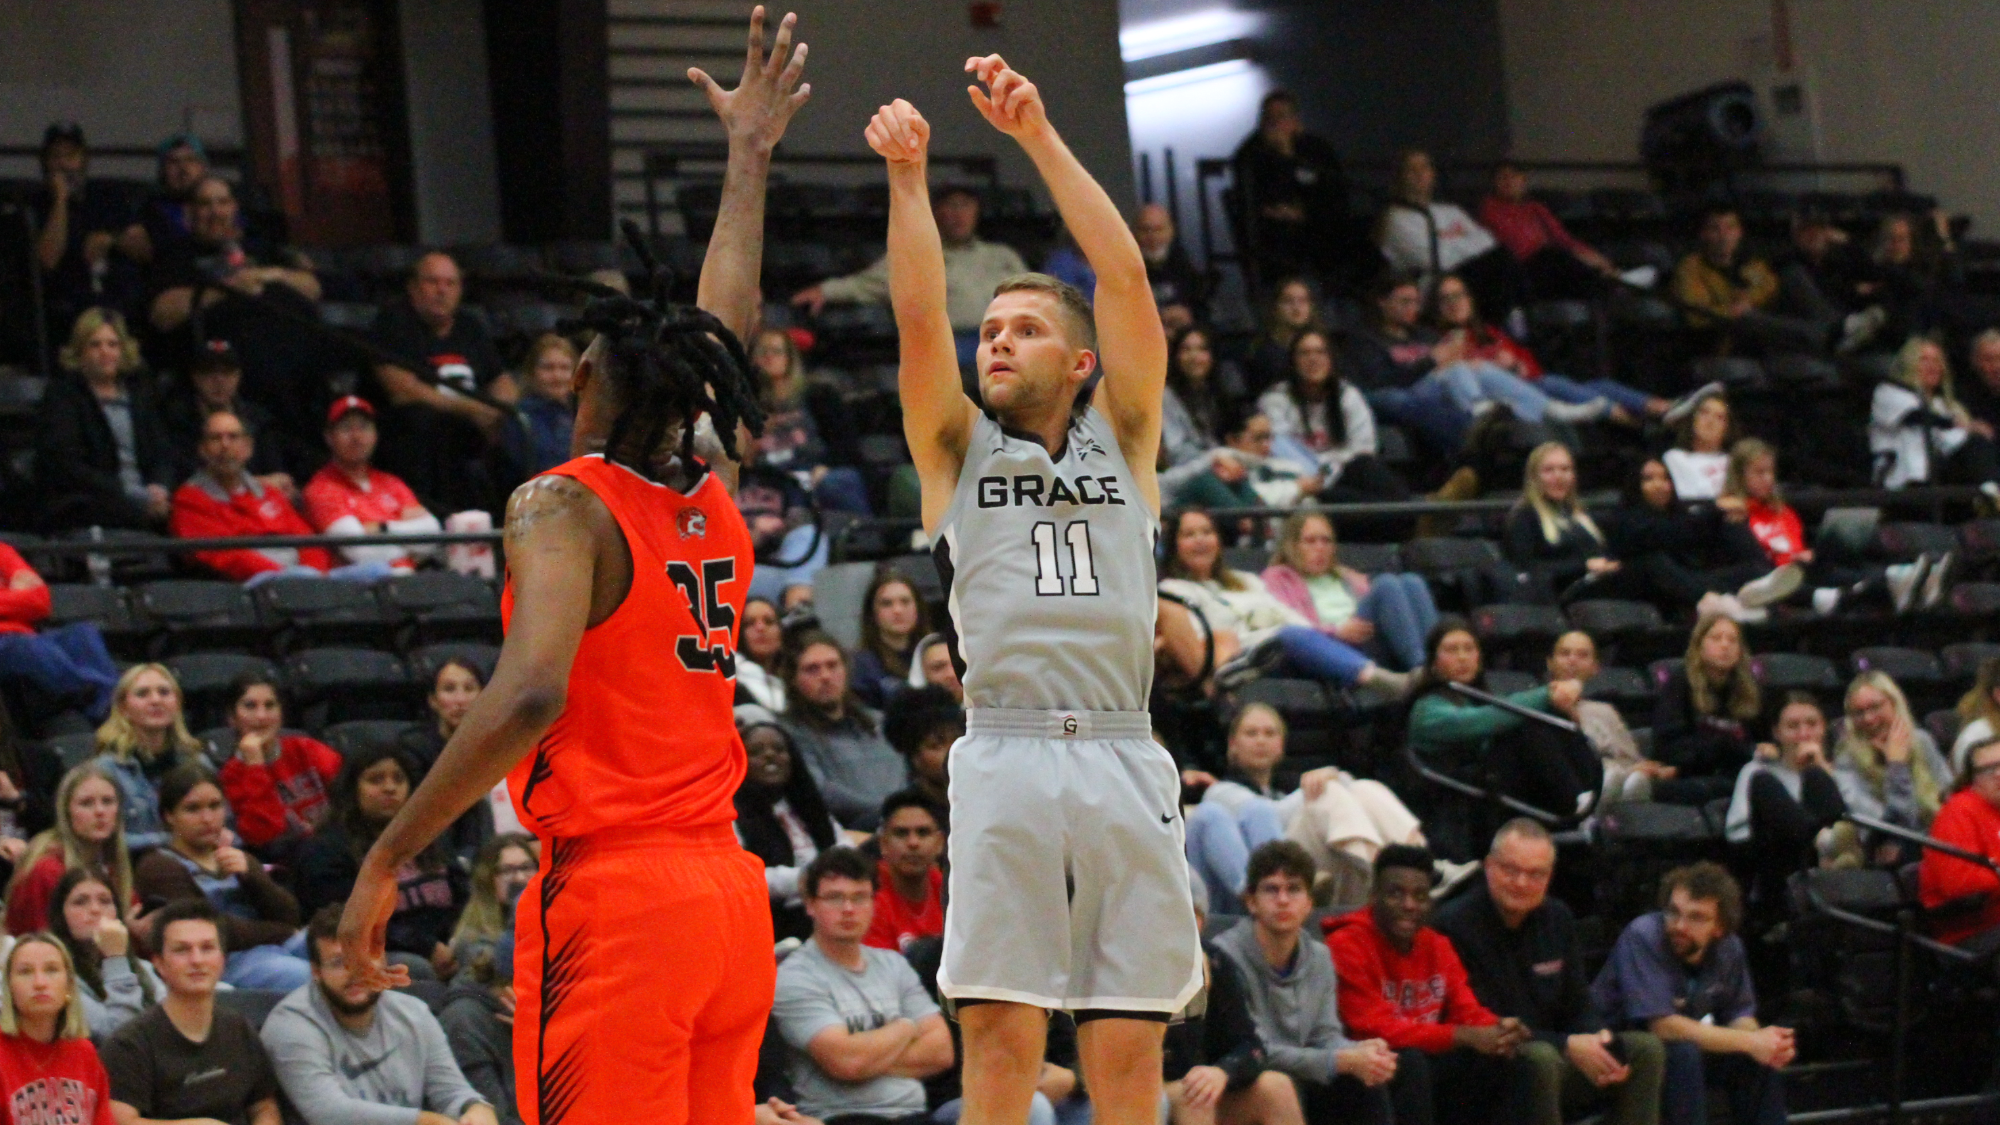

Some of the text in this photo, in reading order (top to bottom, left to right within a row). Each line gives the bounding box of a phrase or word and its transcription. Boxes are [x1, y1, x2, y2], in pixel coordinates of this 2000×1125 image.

[978, 475, 1126, 508] GRACE
[1031, 520, 1100, 596] 11
[666, 556, 736, 681] 35
